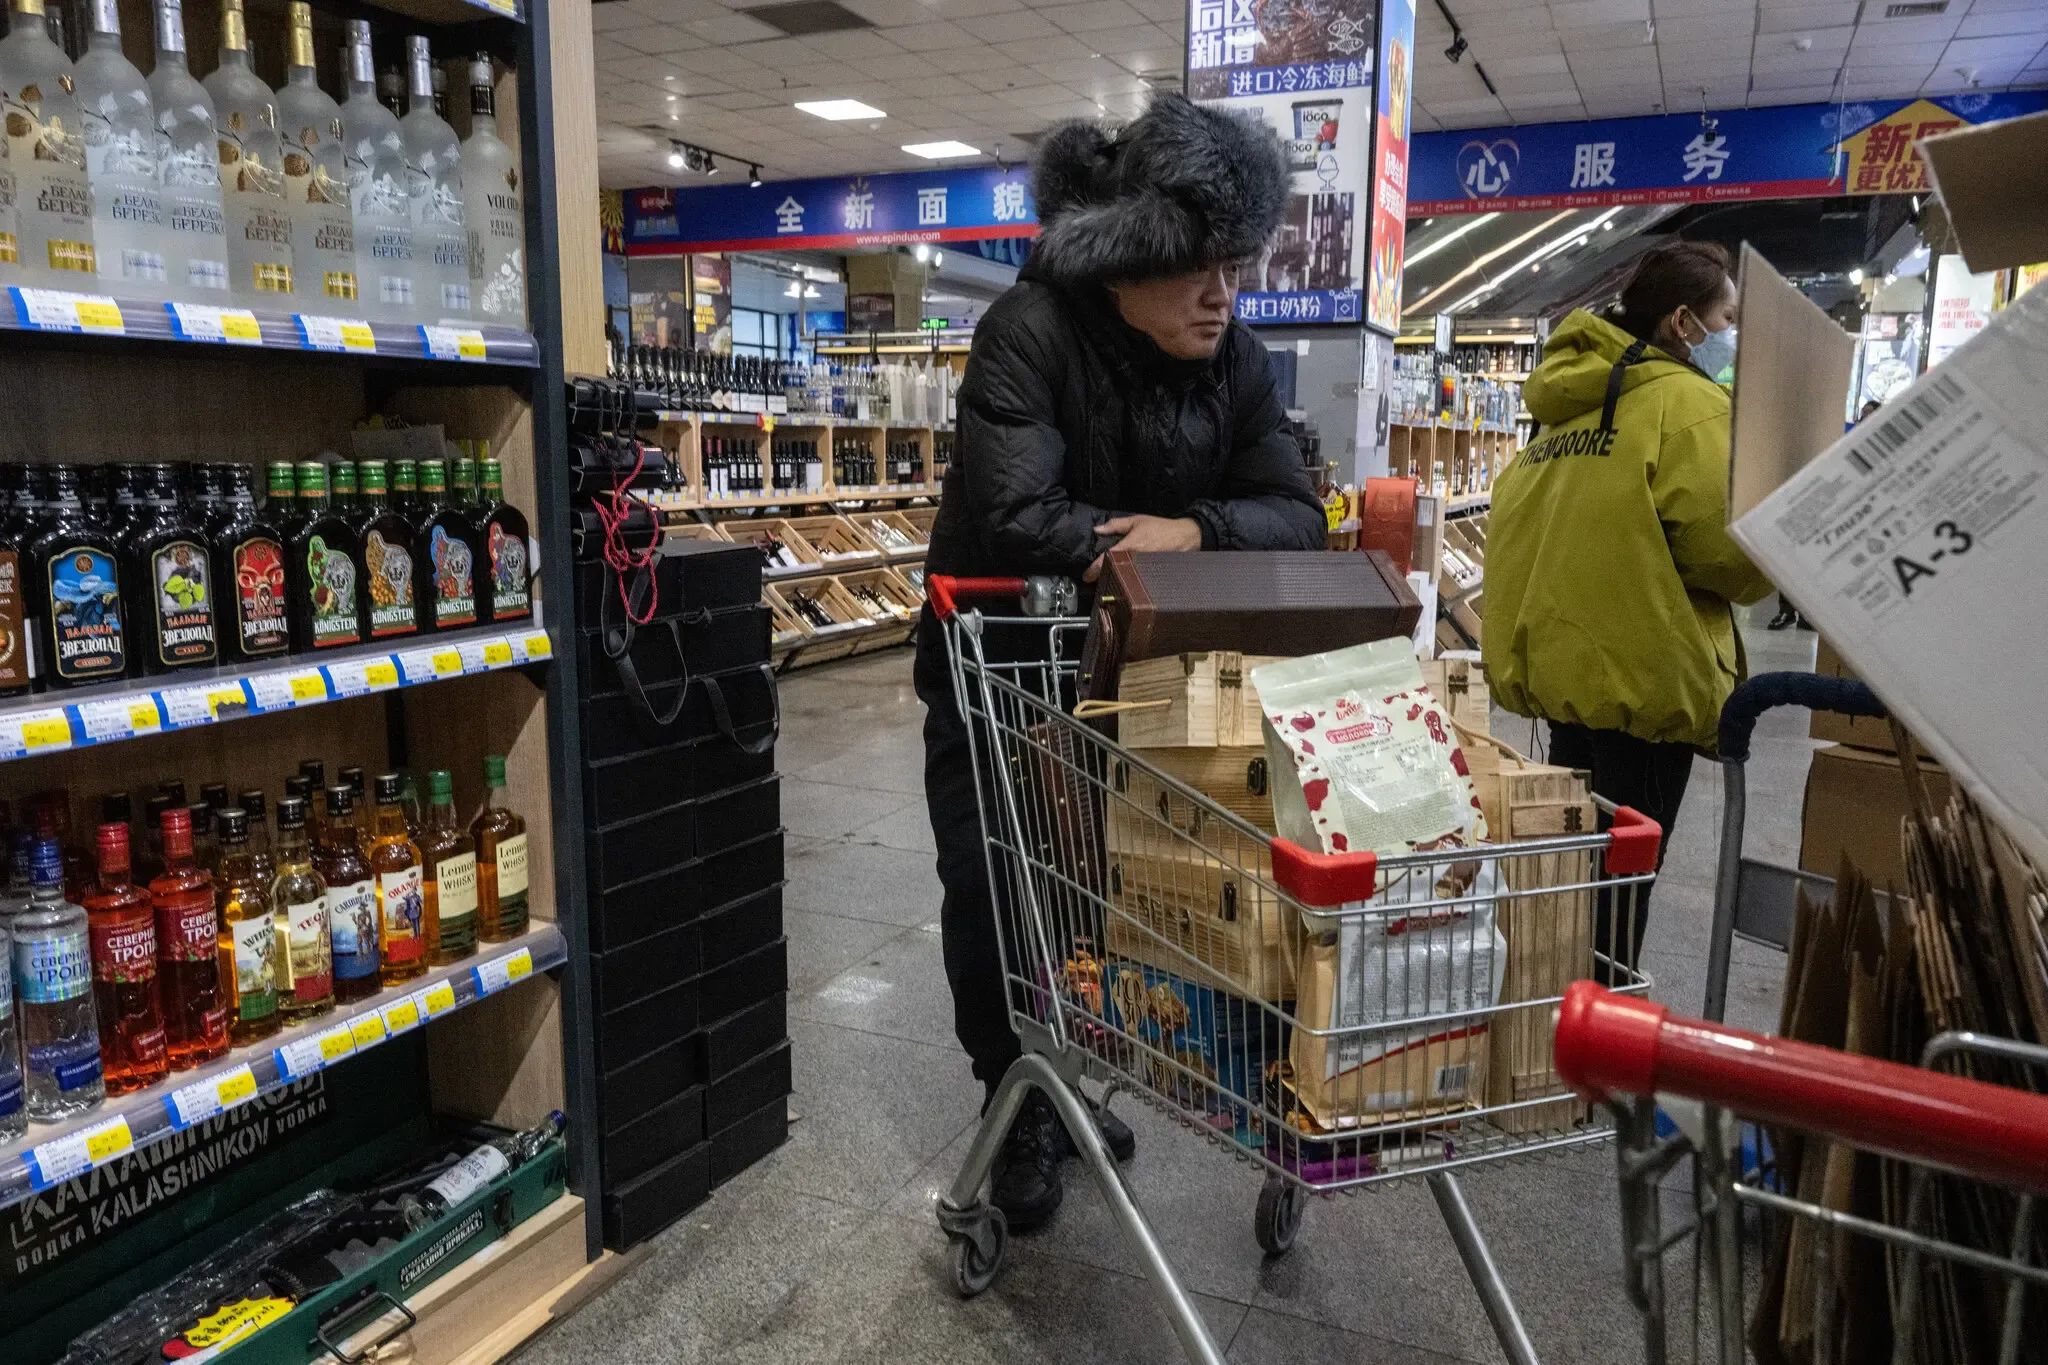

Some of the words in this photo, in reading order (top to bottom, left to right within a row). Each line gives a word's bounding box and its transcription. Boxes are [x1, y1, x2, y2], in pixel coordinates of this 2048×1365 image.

[1232, 61, 1370, 96] 进口冷冻海鲜
[1853, 162, 1933, 192] 更优
[775, 181, 1028, 233] 全新面貌
[856, 231, 941, 245] www.epinduo.com
[1239, 296, 1321, 320] 进口奶粉
[1893, 520, 1973, 597] A-3
[436, 599, 475, 616] KÖNIGSTEIN
[493, 594, 528, 609] KÖNIGSTEIN
[242, 617, 288, 638] ЗВЕЗДОПАД
[314, 616, 357, 635] KÖNIGSTEIN
[371, 607, 414, 624] KÖNIGSTEIN
[60, 635, 121, 660] ЗВЕЗДОПАД
[161, 625, 214, 647] ЗВЕЗДОПАД
[91, 1116, 270, 1235] KALASHNIKOV
[276, 1096, 328, 1134] VODKA
[16, 1224, 87, 1275] ВОДКА
